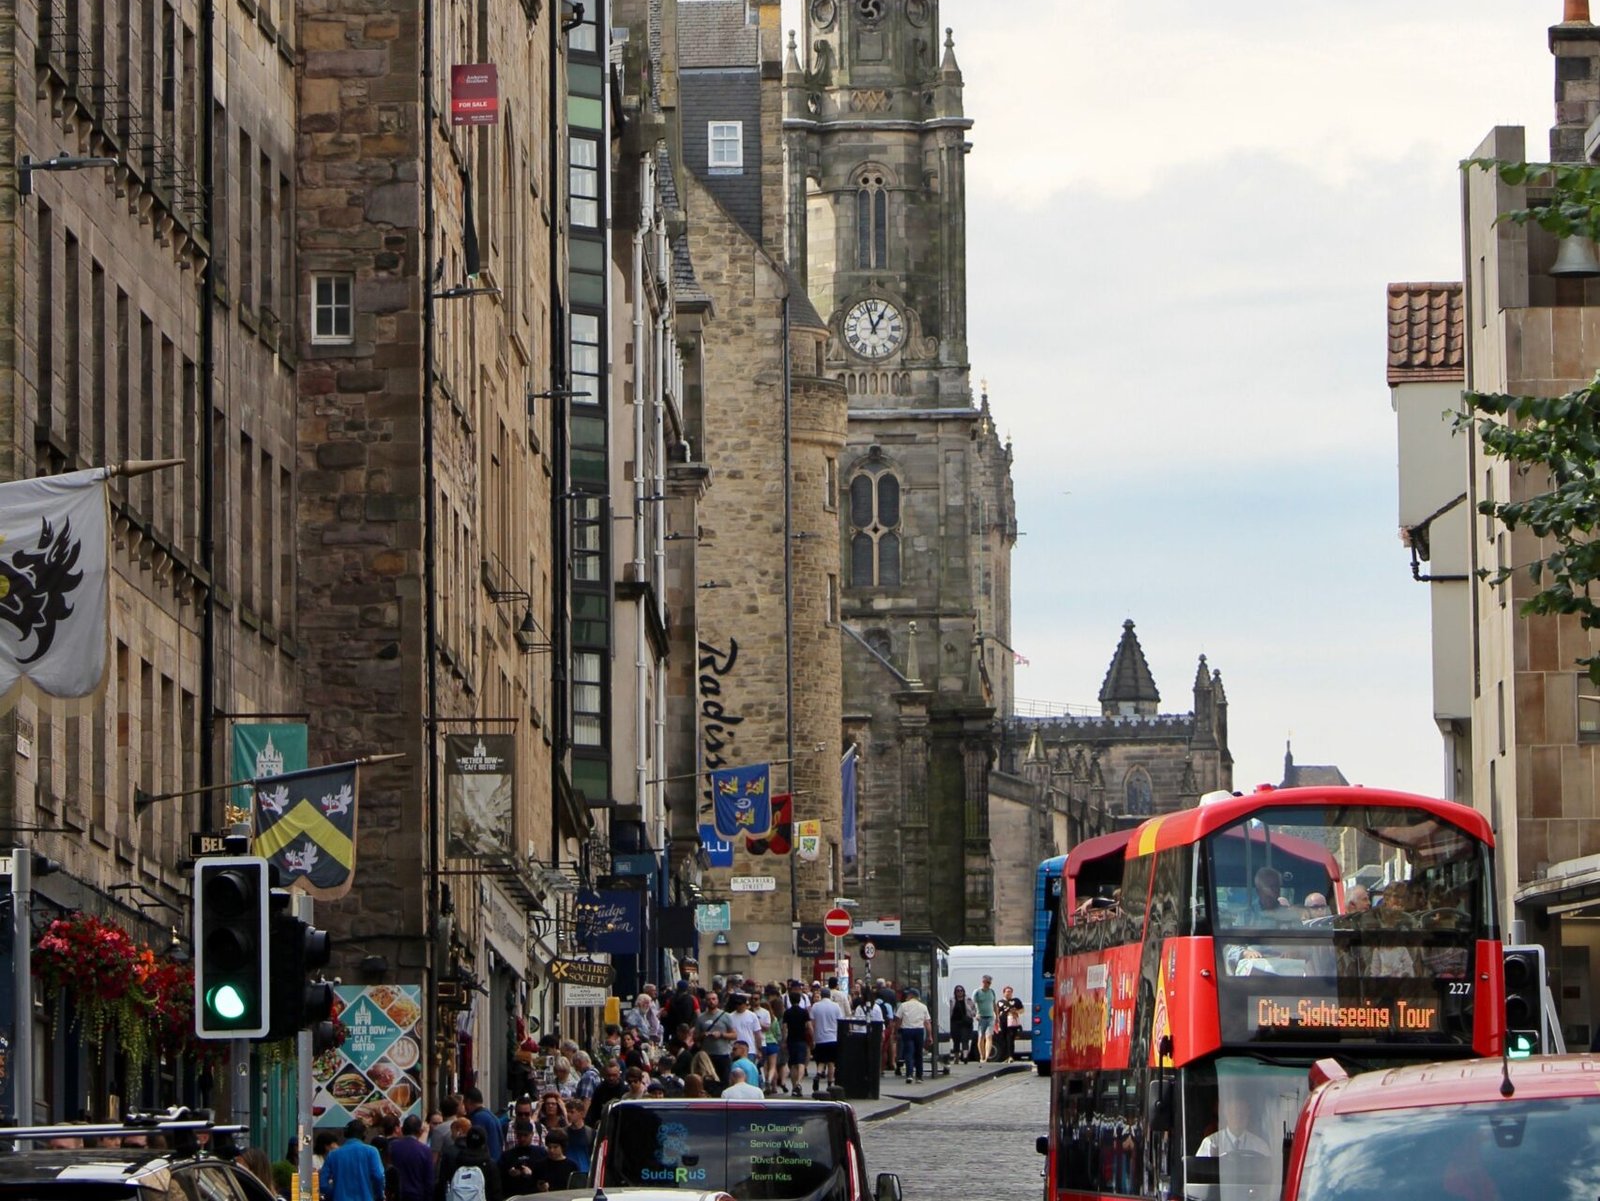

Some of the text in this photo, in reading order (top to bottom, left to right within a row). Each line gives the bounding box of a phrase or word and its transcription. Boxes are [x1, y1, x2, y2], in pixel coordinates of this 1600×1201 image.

[866, 946, 875, 954] 20
[570, 962, 609, 974] SALTIRE
[569, 973, 608, 984] SOCIETY
[1449, 983, 1471, 995] 227
[1258, 999, 1436, 1028] City Sightseeing Tour
[346, 1026, 367, 1035] THER
[369, 1026, 387, 1035] BOW
[351, 1043, 375, 1051] BISTRO
[750, 1123, 803, 1134] Dry Cleaning
[750, 1140, 809, 1149] Service Wash
[750, 1156, 812, 1166] Duvet Cleaning
[641, 1167, 706, 1183] SudsRuS
[751, 1172, 792, 1181] Team Kits
